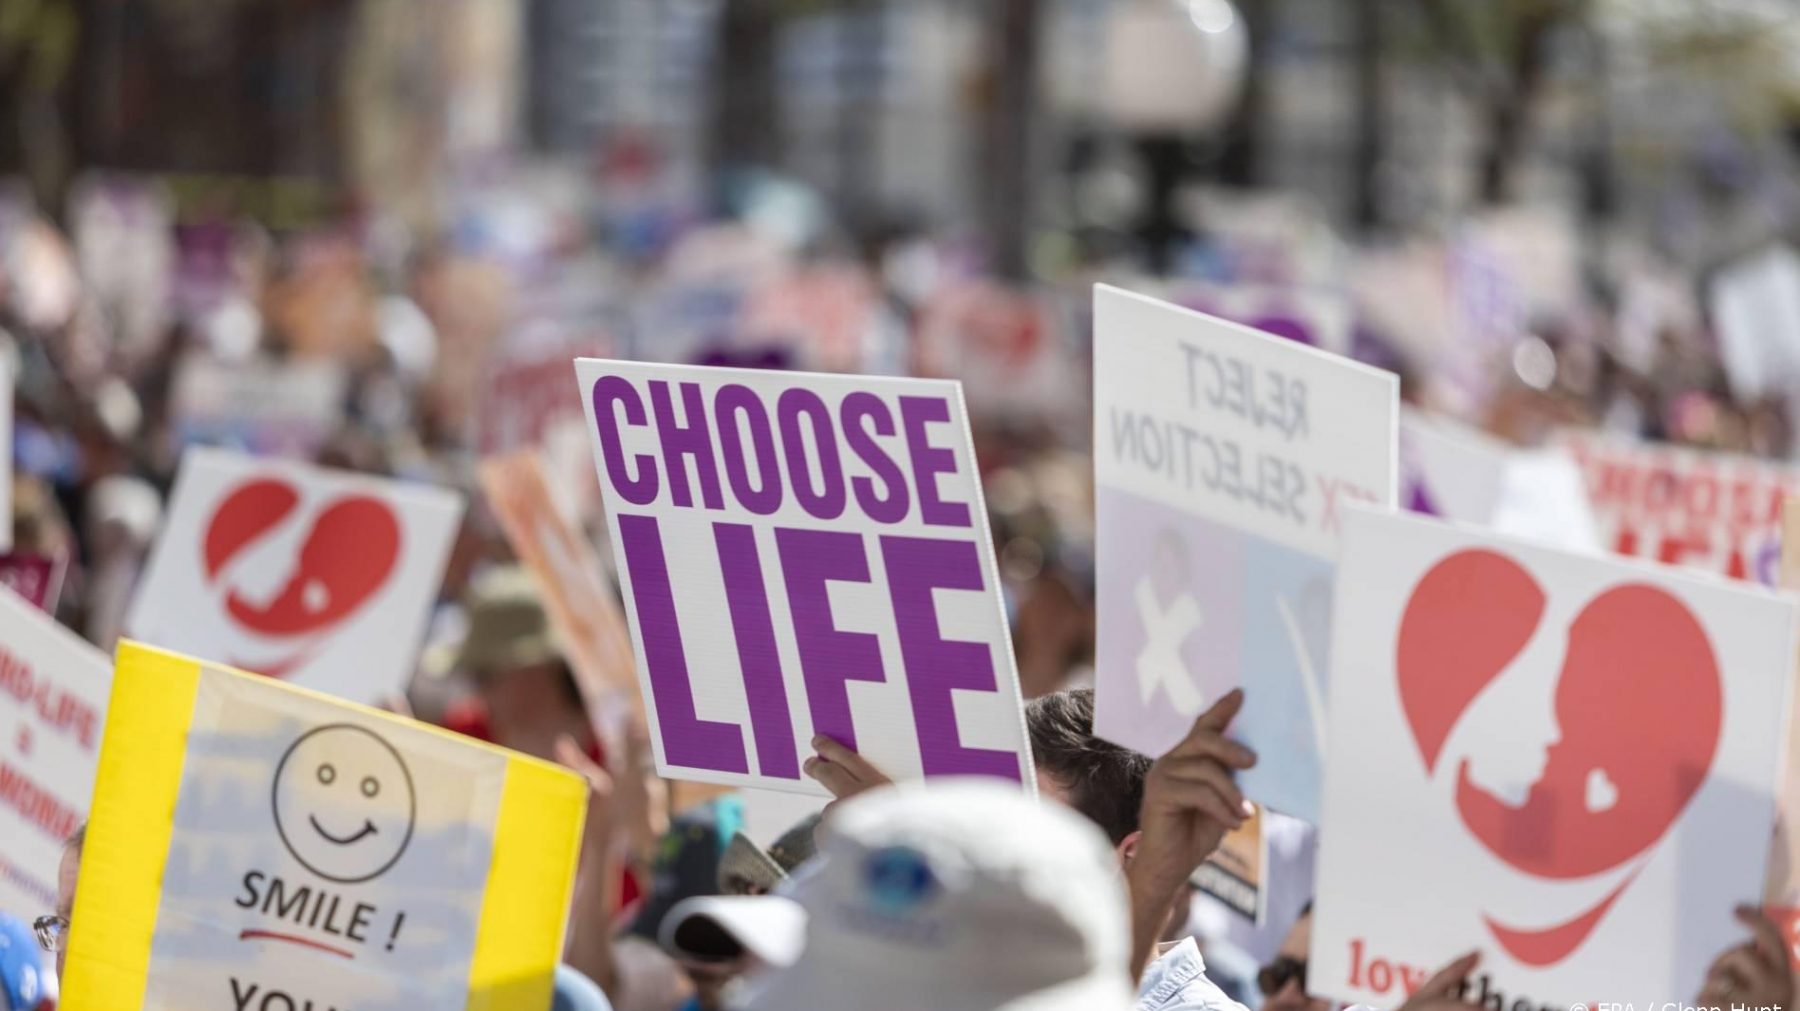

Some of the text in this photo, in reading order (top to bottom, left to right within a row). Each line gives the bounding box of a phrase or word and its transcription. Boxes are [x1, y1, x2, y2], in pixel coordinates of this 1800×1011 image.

[592, 374, 974, 529] CHOOSE
[616, 513, 1024, 795] LIFE
[235, 869, 377, 944] SMILE
